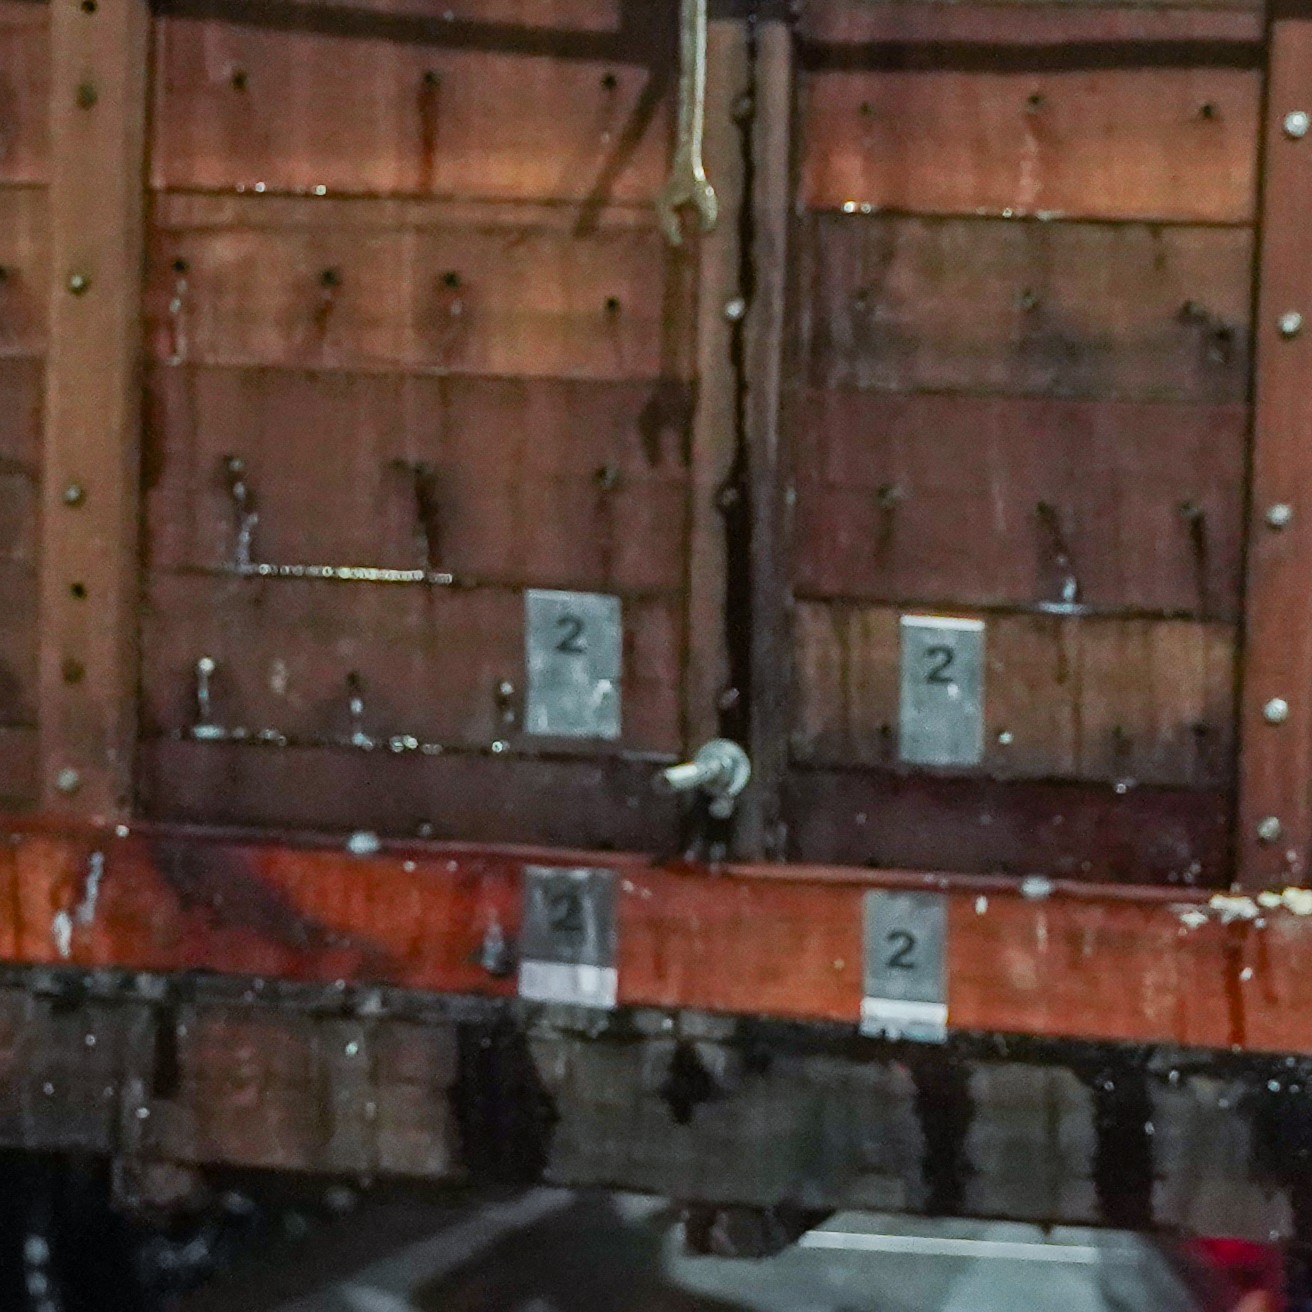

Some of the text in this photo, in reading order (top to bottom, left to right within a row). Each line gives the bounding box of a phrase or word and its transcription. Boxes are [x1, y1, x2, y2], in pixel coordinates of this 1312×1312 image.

[554, 614, 587, 655] 2
[924, 644, 954, 685] 2
[886, 930, 917, 970] 2
